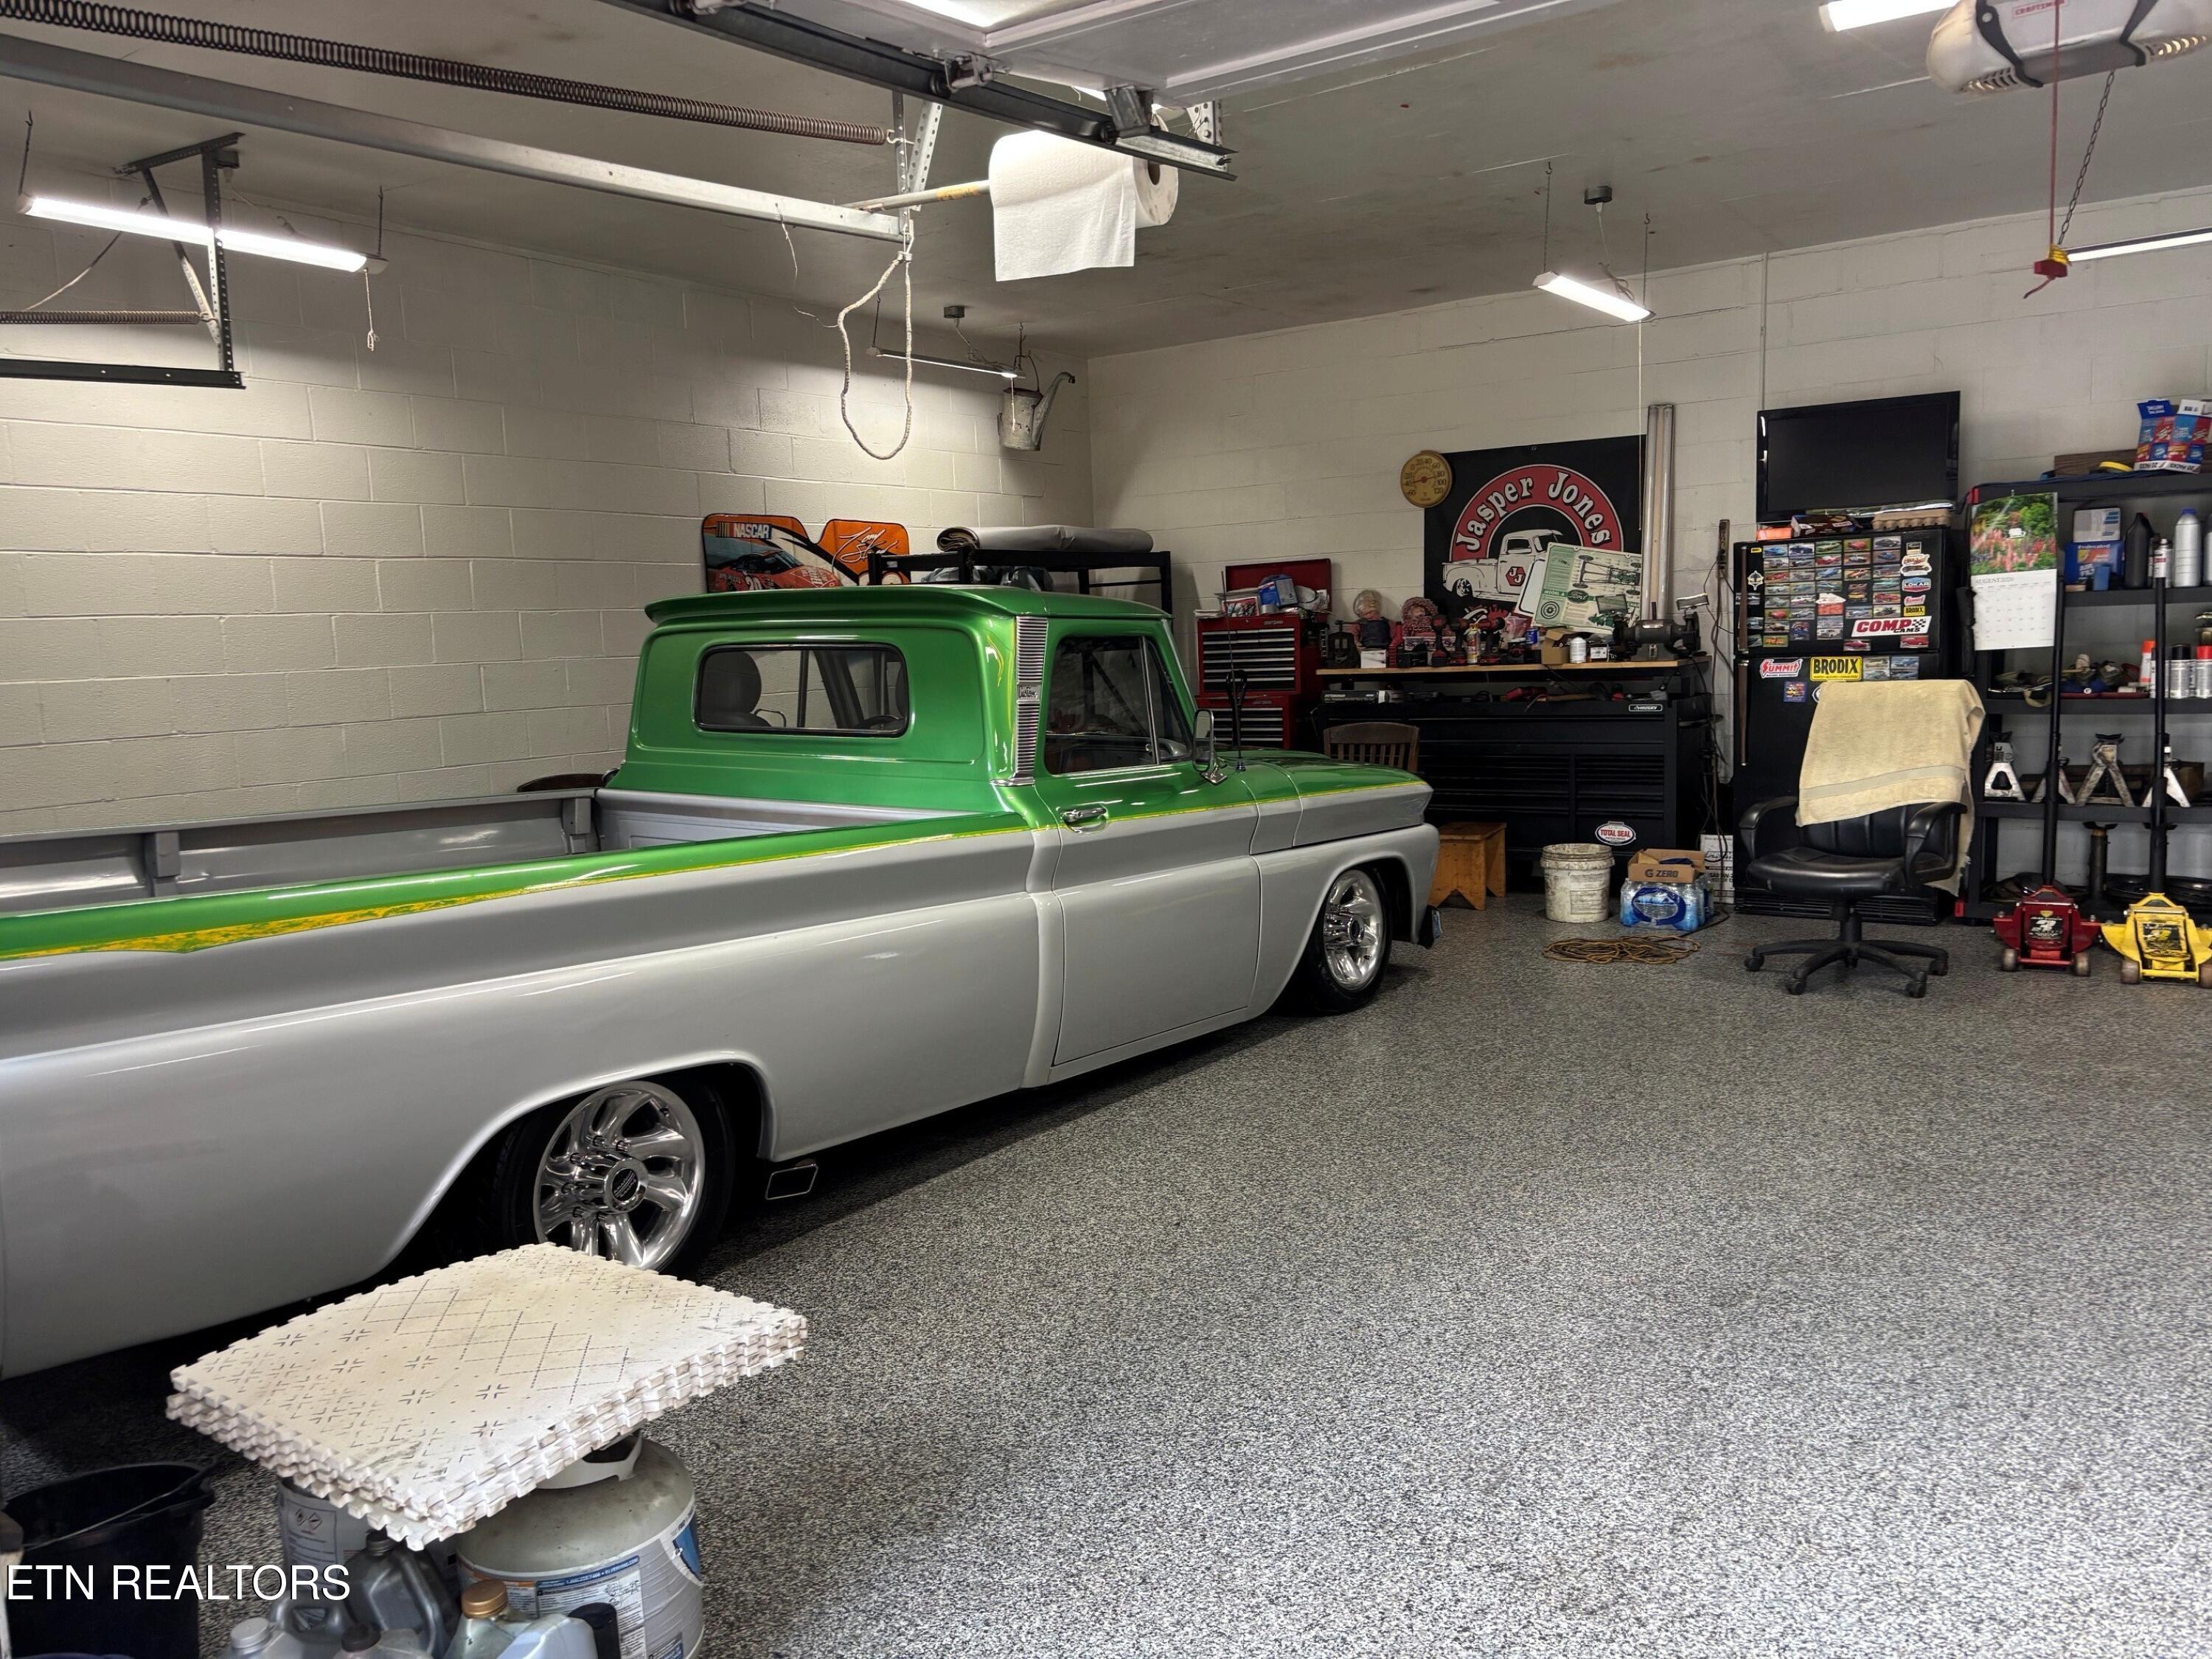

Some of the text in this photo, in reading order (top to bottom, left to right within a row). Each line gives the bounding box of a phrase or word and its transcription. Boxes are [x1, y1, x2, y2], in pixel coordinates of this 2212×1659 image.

[1456, 472, 1611, 551] Jasper Jones
[733, 524, 770, 540] NASCAR
[1568, 591, 1588, 601] Ford
[1857, 619, 1912, 633] COMP
[1813, 658, 1859, 675] BRODIX
[1600, 829, 1616, 837] TOTAL
[1655, 870, 1679, 878] ZERO
